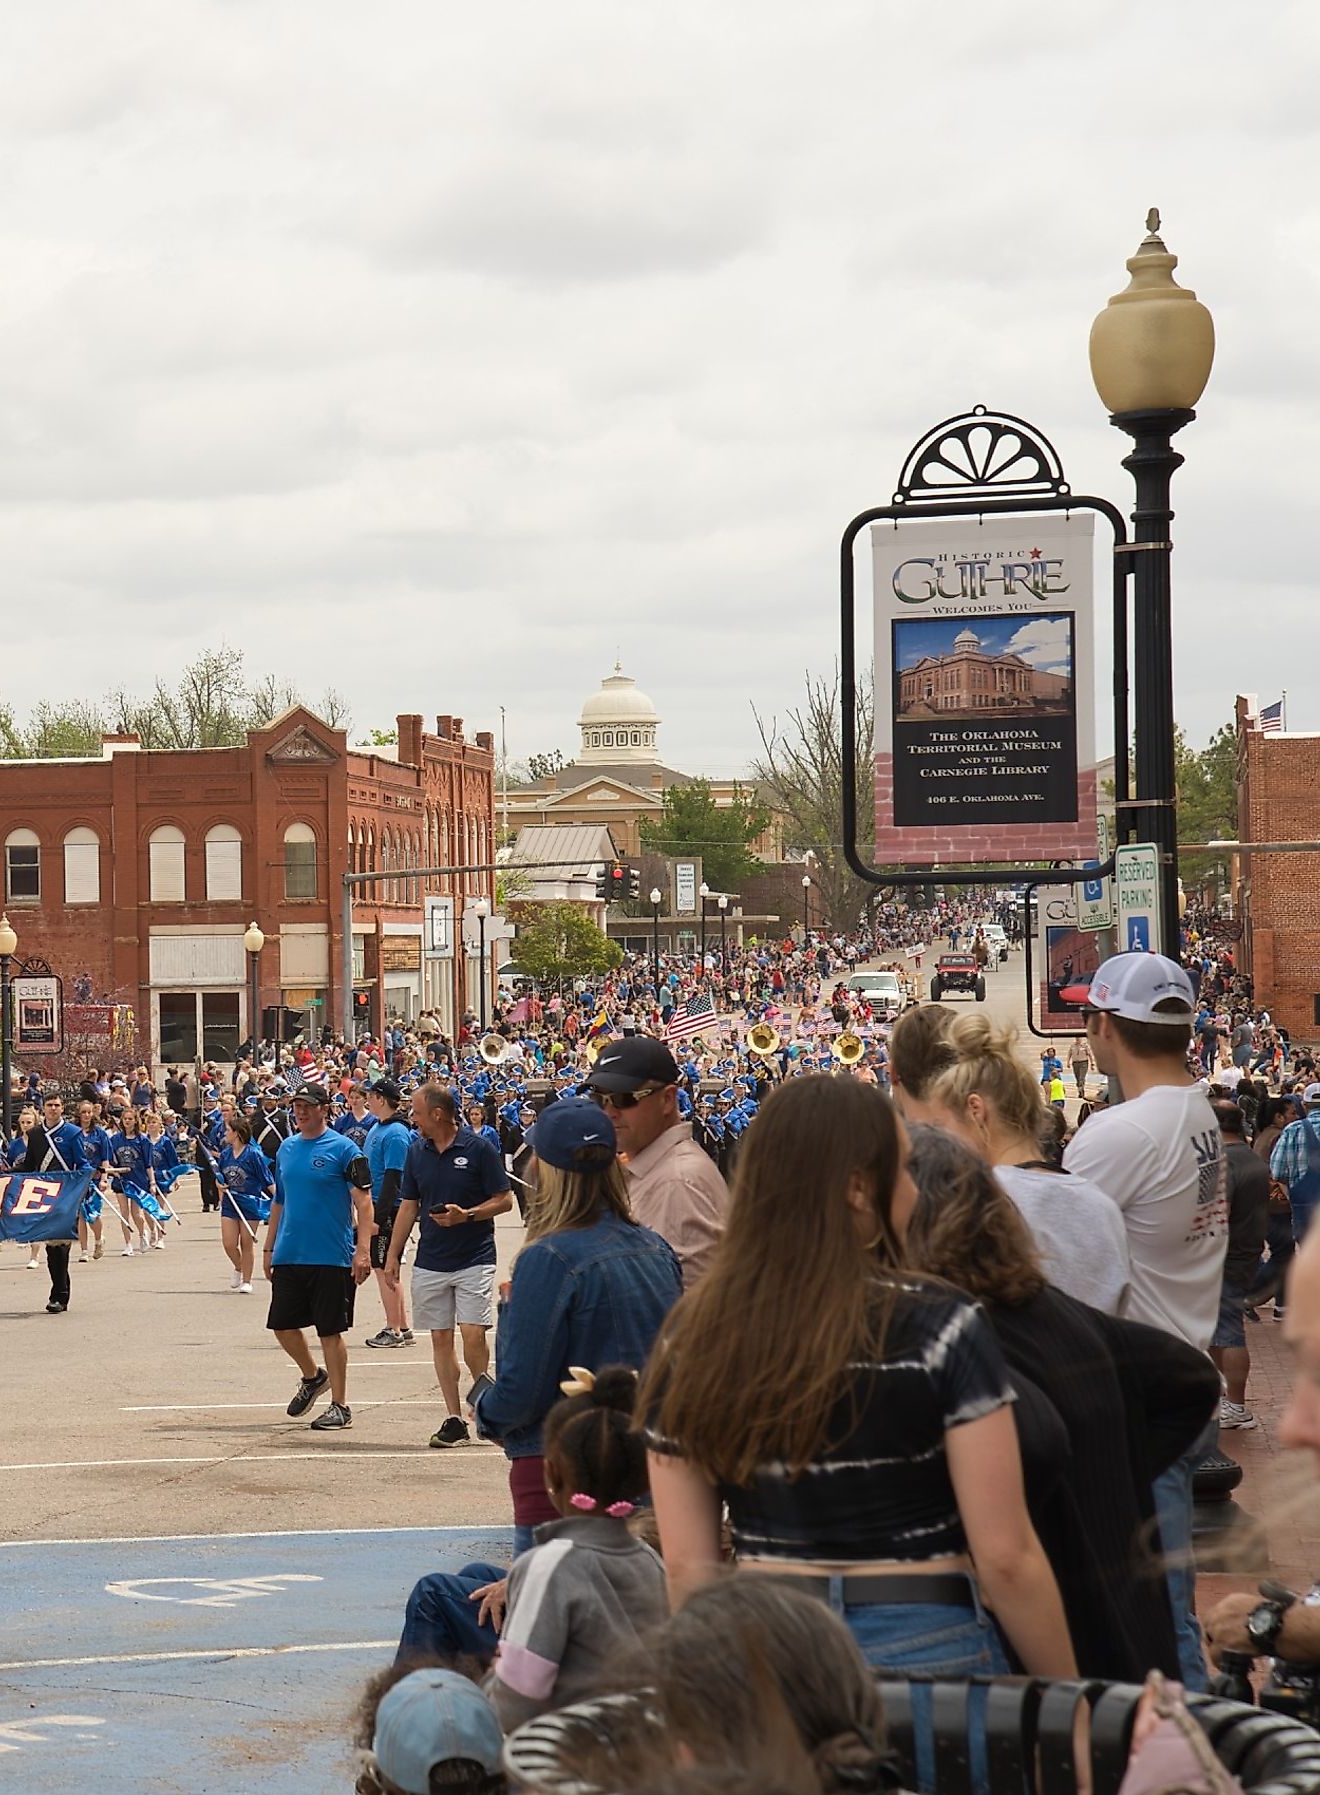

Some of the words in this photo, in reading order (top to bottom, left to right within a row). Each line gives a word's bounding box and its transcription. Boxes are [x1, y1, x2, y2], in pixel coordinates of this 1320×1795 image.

[939, 550, 1025, 562] HISTORIC
[892, 557, 1071, 604] GUTHRIE
[932, 604, 1003, 614] WELCOMES
[1008, 602, 1032, 611] YOU
[929, 732, 958, 742] THE
[962, 730, 1039, 741] OKLAHOMA
[906, 744, 998, 754] TERRITORIAL
[1001, 741, 1062, 750] MUSEUM
[920, 767, 988, 778] CARNEGIE
[992, 765, 1050, 775] LIBRARY
[962, 795, 1019, 803] OKLAHOMA
[1119, 861, 1156, 882] RESERVED
[1121, 887, 1154, 910] PARKING
